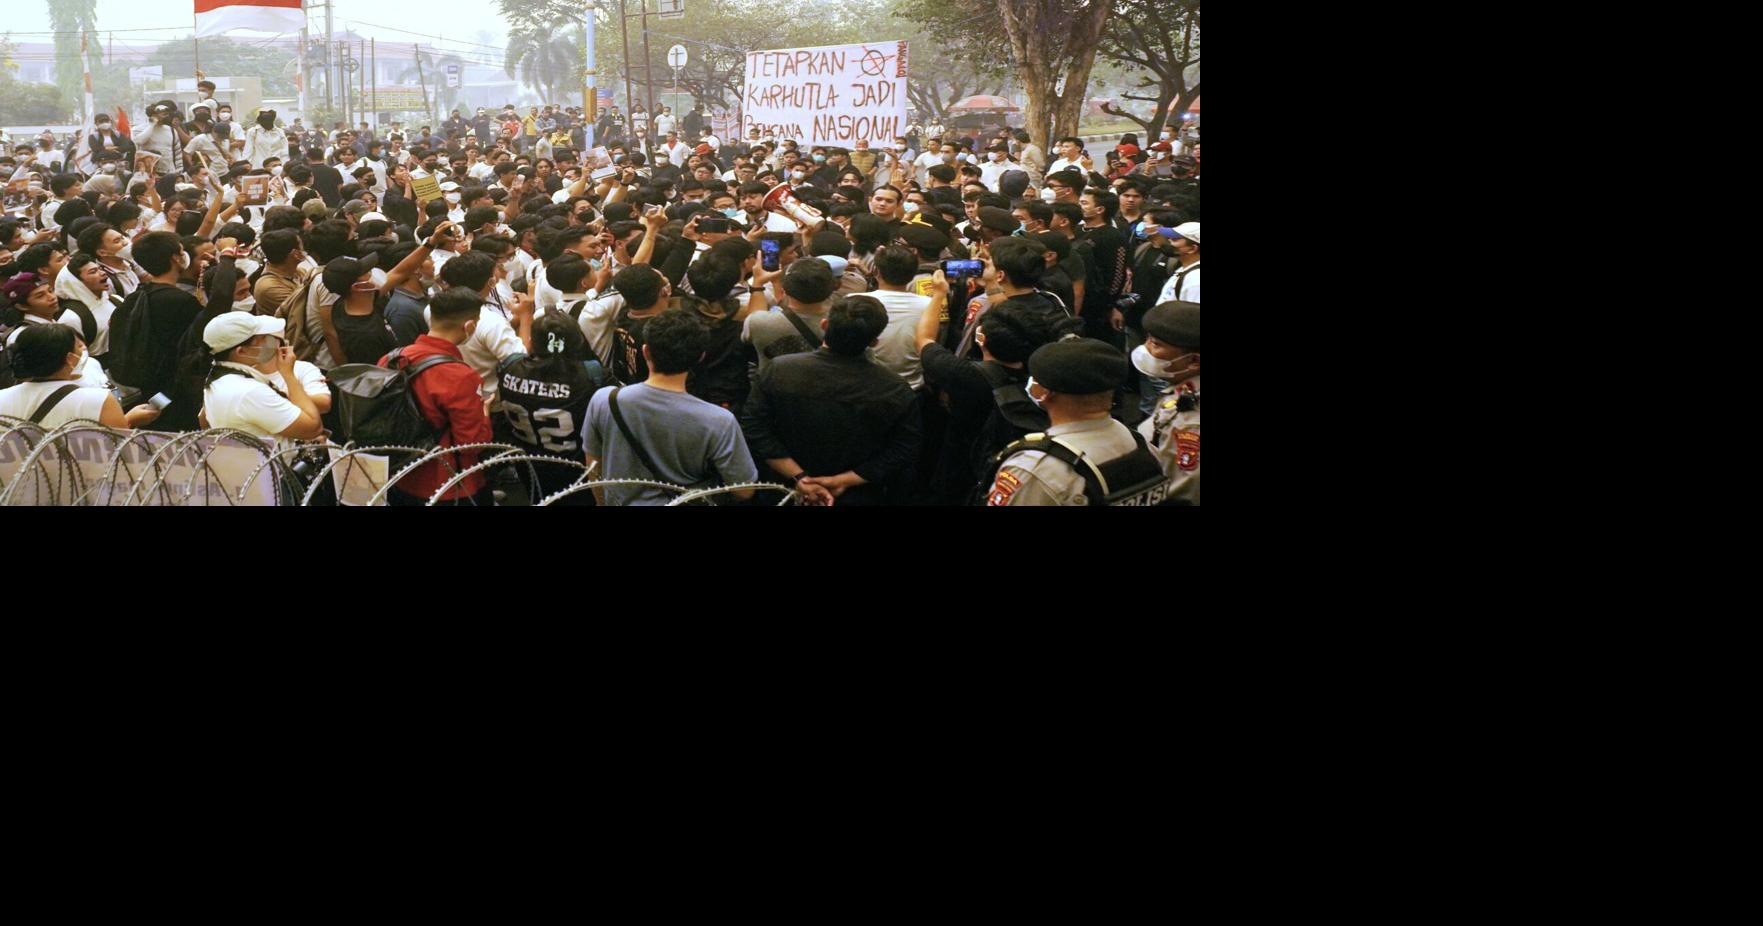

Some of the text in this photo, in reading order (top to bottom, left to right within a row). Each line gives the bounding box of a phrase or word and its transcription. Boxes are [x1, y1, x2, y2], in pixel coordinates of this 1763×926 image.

[747, 51, 845, 78] TETAPKAN
[746, 80, 896, 111] KARHUTLA JADI
[812, 113, 899, 143] NASIONAL
[502, 373, 571, 399] SKATERS
[502, 399, 578, 453] 92
